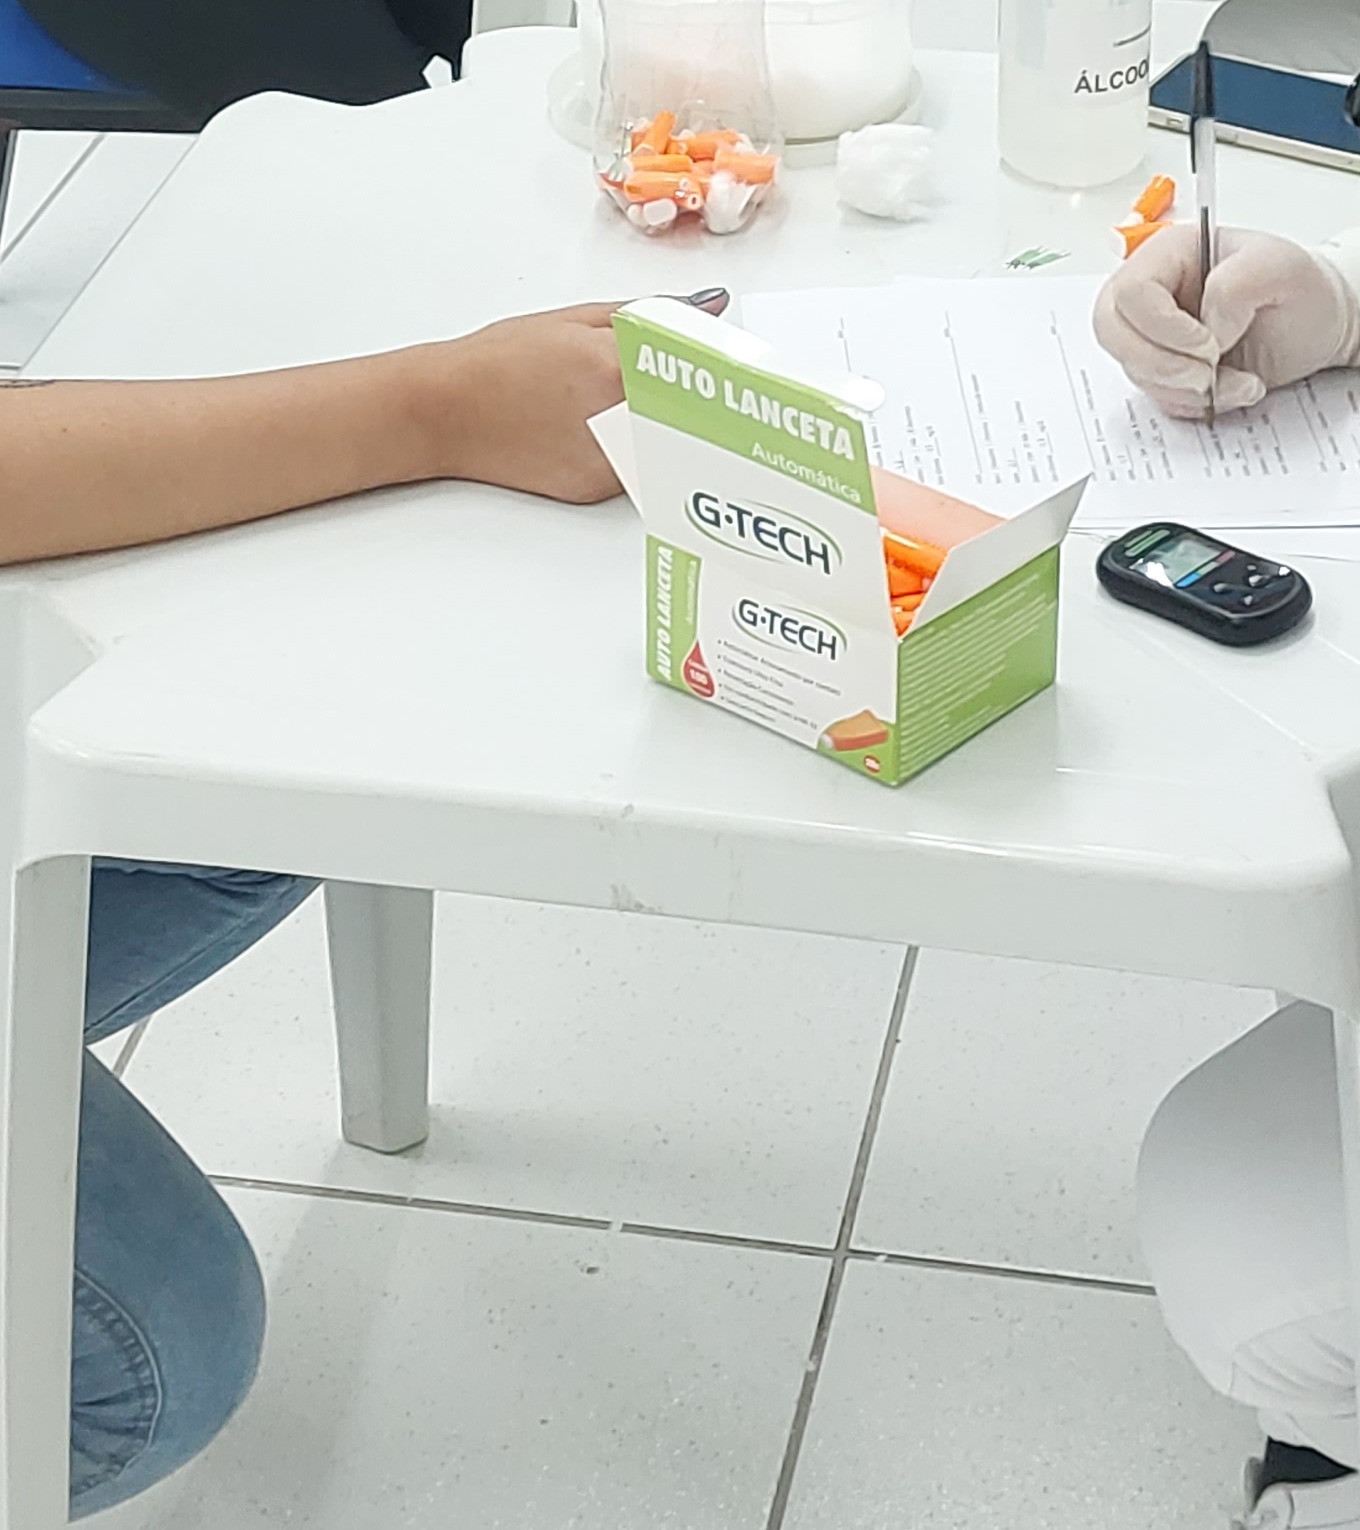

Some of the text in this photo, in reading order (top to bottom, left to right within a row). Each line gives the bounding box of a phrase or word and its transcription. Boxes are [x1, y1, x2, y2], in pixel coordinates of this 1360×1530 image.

[636, 343, 717, 400] AUTO
[723, 378, 857, 461] LANCETA
[751, 441, 862, 503] Automática
[655, 545, 674, 682] AUTO LANCETA
